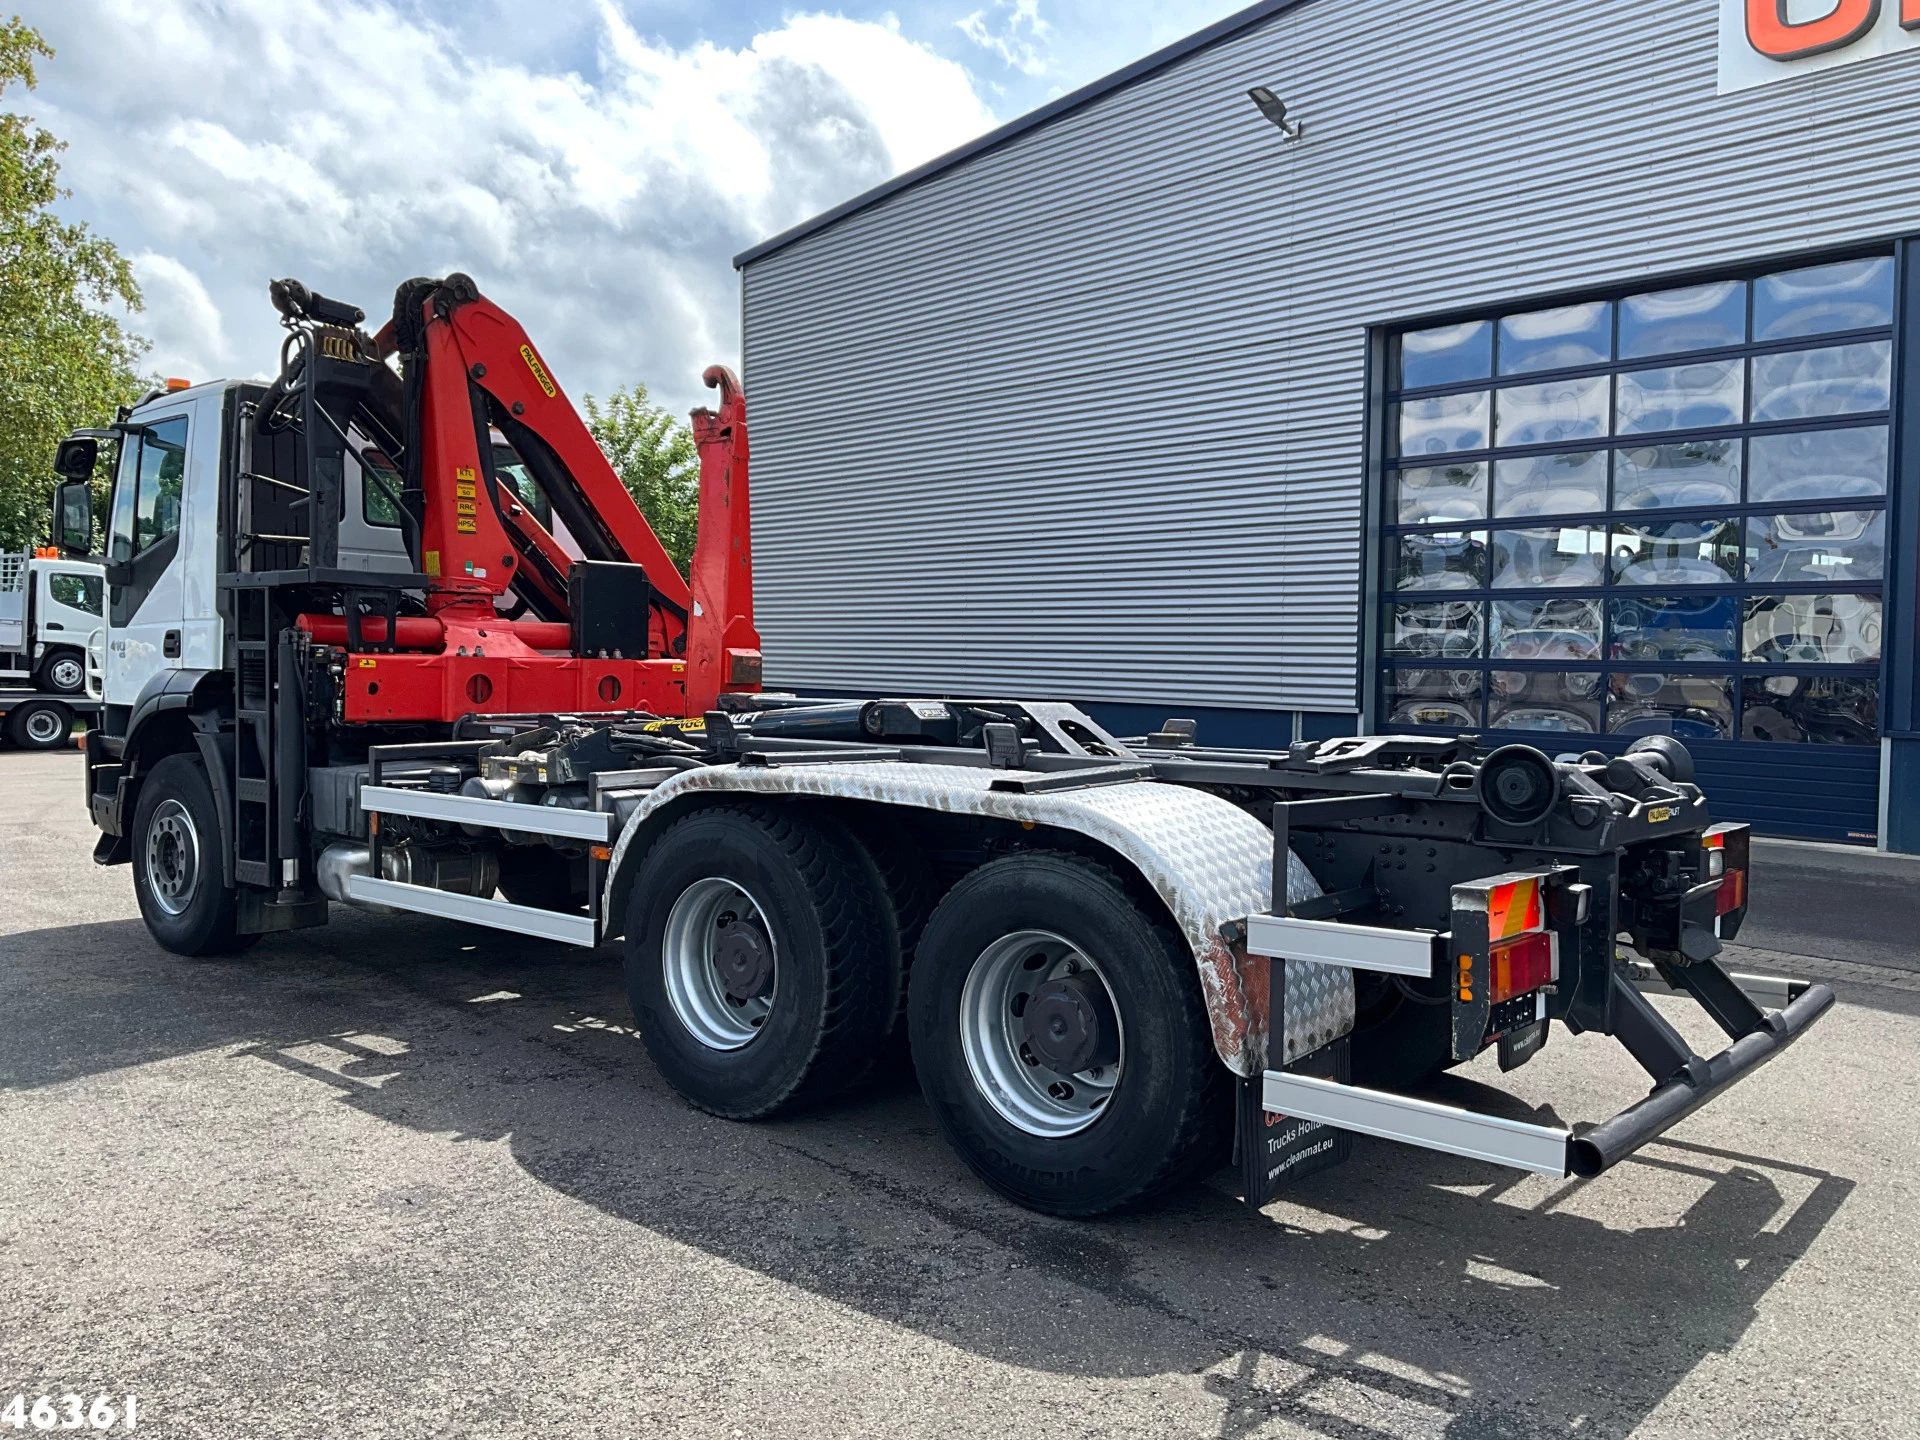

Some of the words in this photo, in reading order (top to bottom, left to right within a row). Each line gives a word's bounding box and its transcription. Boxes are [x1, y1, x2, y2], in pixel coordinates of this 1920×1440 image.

[521, 347, 554, 395] PALFINGER
[459, 469, 473, 477] KTL
[1267, 1128, 1296, 1154] Trucks
[1268, 1138, 1333, 1180] www.cleanmat.eu
